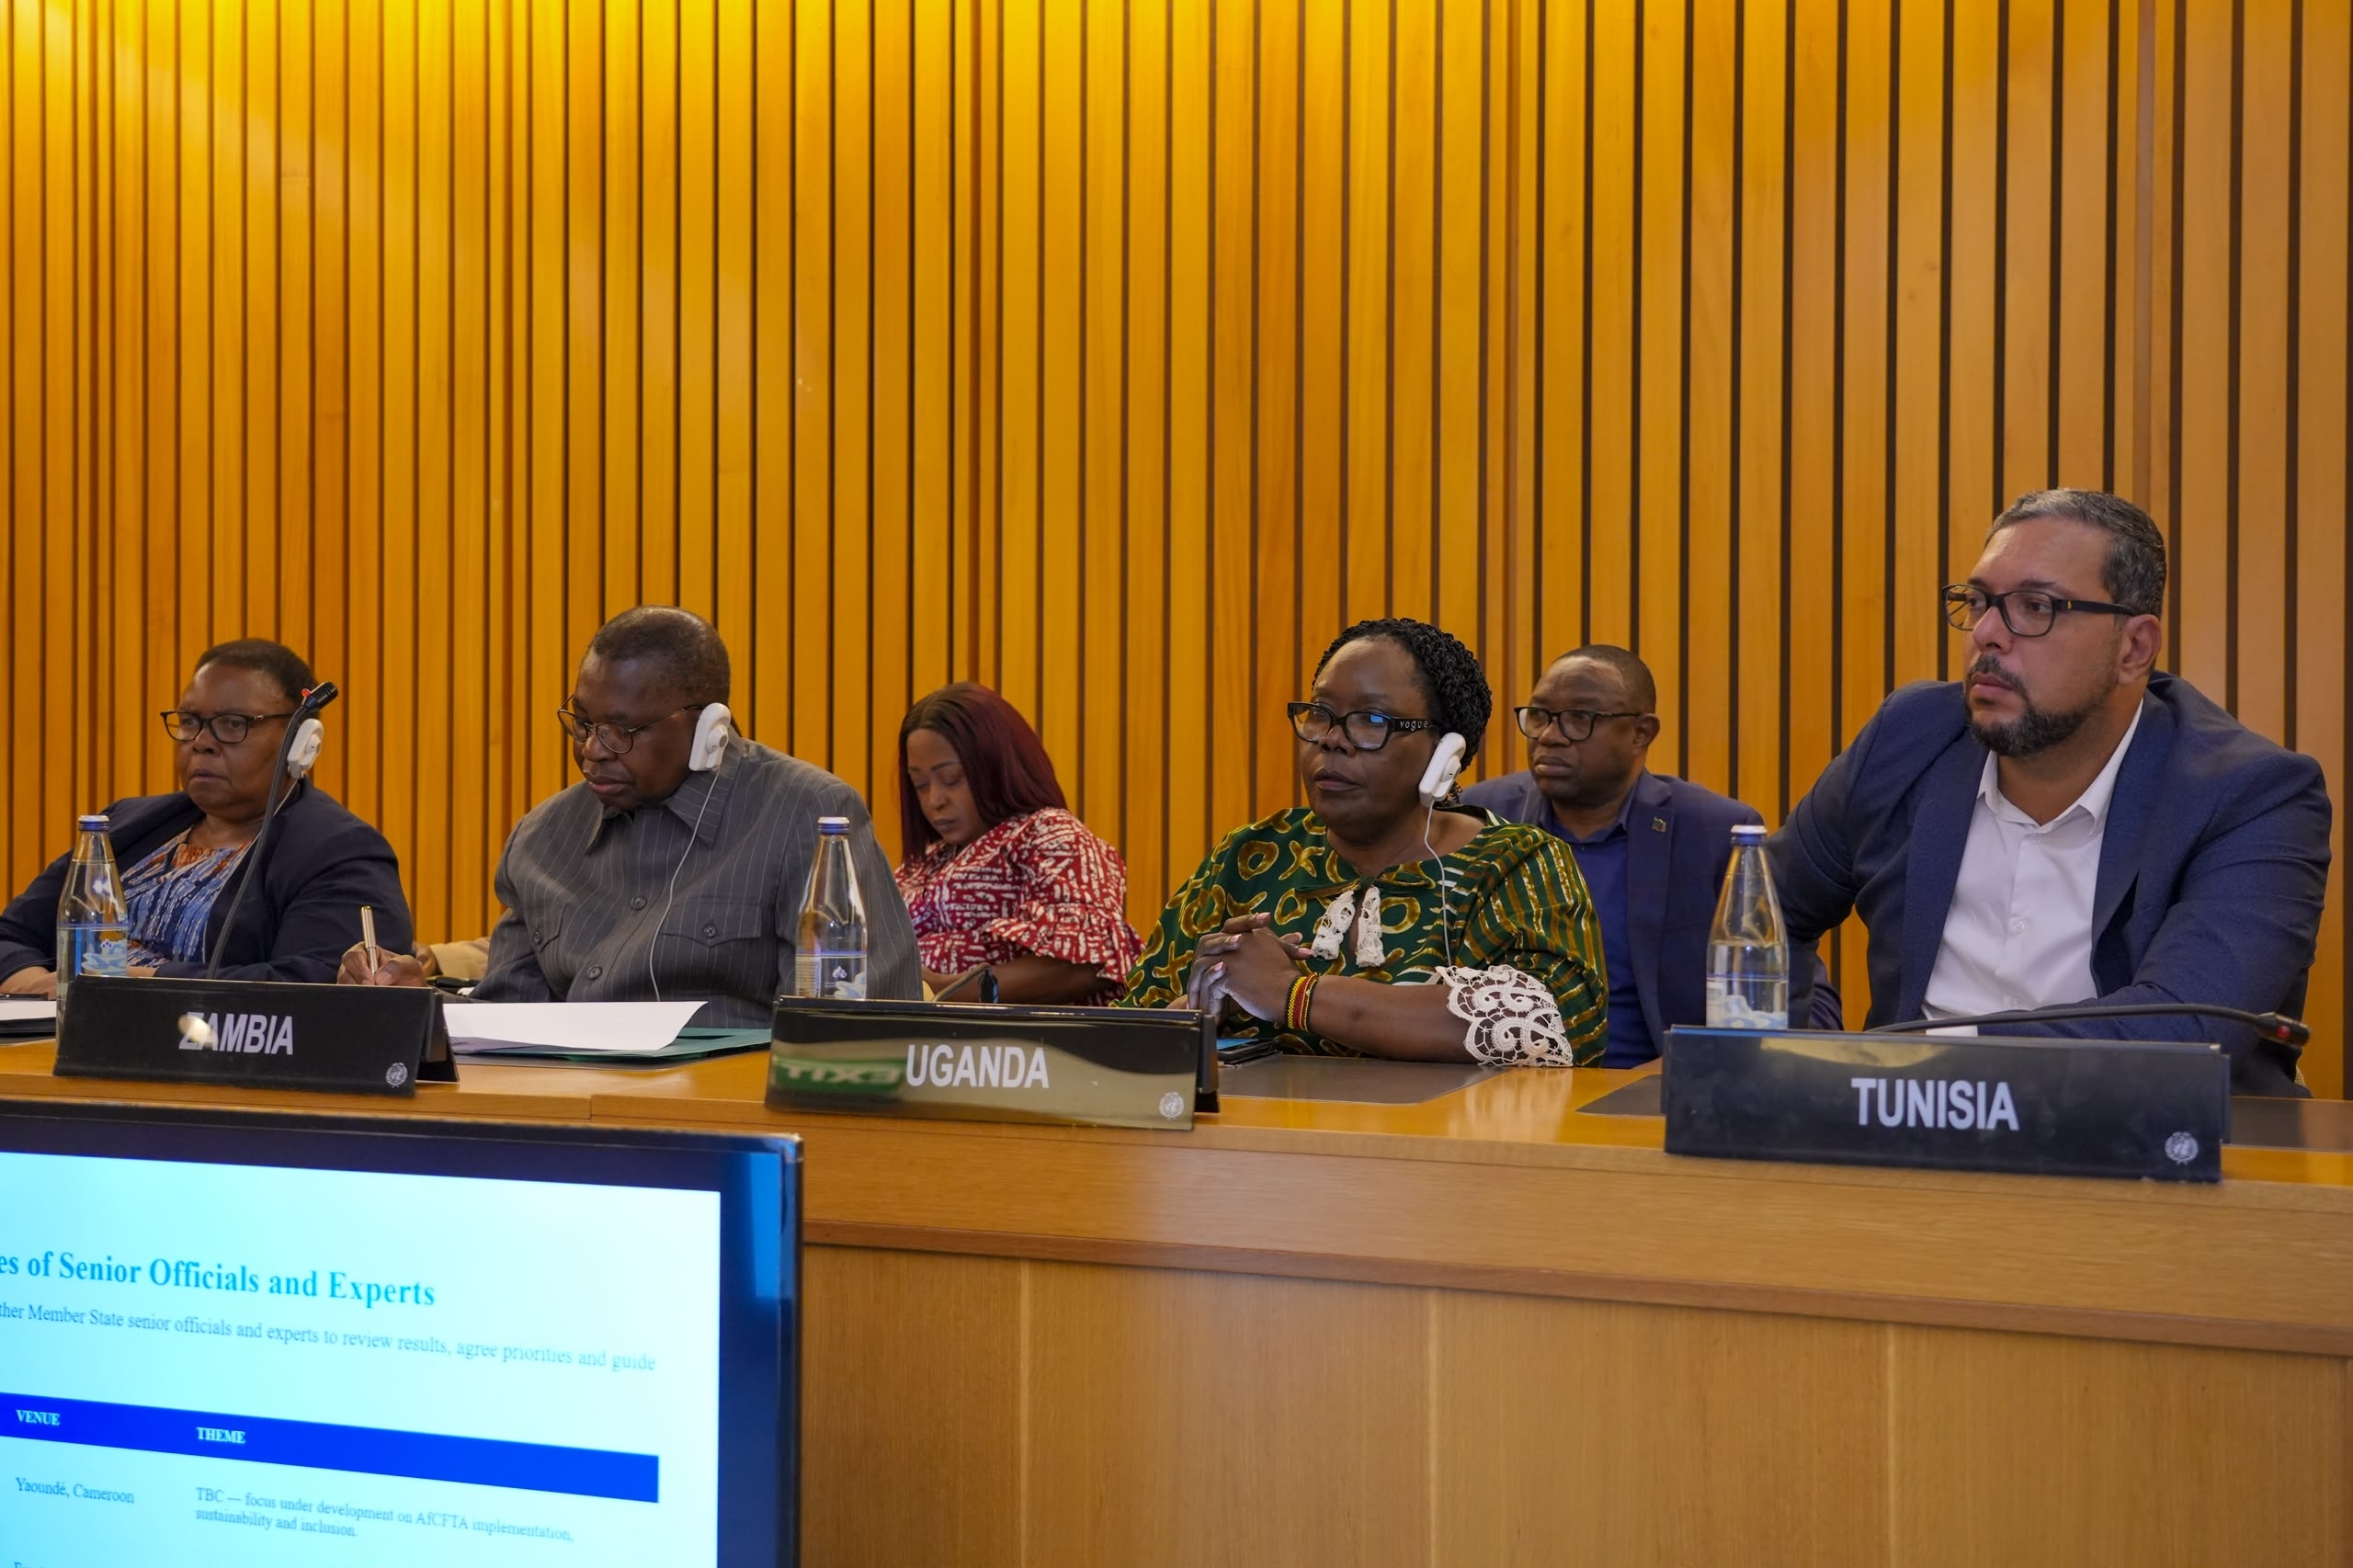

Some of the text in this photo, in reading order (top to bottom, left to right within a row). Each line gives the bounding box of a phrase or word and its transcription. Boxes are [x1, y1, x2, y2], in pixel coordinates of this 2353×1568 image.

[1399, 721, 1428, 732] vogue
[905, 1044, 1050, 1088] UGANDA
[1850, 1077, 2020, 1131] TUNISIA
[28, 1251, 53, 1277] of
[59, 1251, 141, 1283] Senior
[150, 1257, 259, 1293] Officials
[268, 1269, 318, 1297] and
[328, 1271, 435, 1309] Experts
[28, 1303, 85, 1324] Member
[89, 1309, 123, 1326] State
[128, 1313, 171, 1331] senior
[175, 1315, 233, 1336] officials
[236, 1322, 263, 1338] and
[267, 1325, 319, 1345] experts
[324, 1330, 338, 1345] to
[342, 1331, 392, 1348] review
[397, 1335, 451, 1356] results,
[456, 1341, 498, 1359] agree
[503, 1344, 574, 1363] priorities
[578, 1349, 607, 1367] and
[612, 1352, 656, 1372] guide
[16, 1409, 61, 1426] VENUE
[196, 1426, 246, 1444] THEME
[16, 1477, 135, 1504] Yaoundé, Cameroon
[196, 1486, 224, 1503] TBC
[244, 1493, 277, 1508] focus
[279, 1498, 313, 1513] under
[317, 1501, 393, 1521] development
[397, 1512, 413, 1523] on
[415, 1512, 469, 1528] AfCFTA
[472, 1519, 574, 1542] implementation,
[196, 1507, 358, 1537] sustainability and inclusion.
